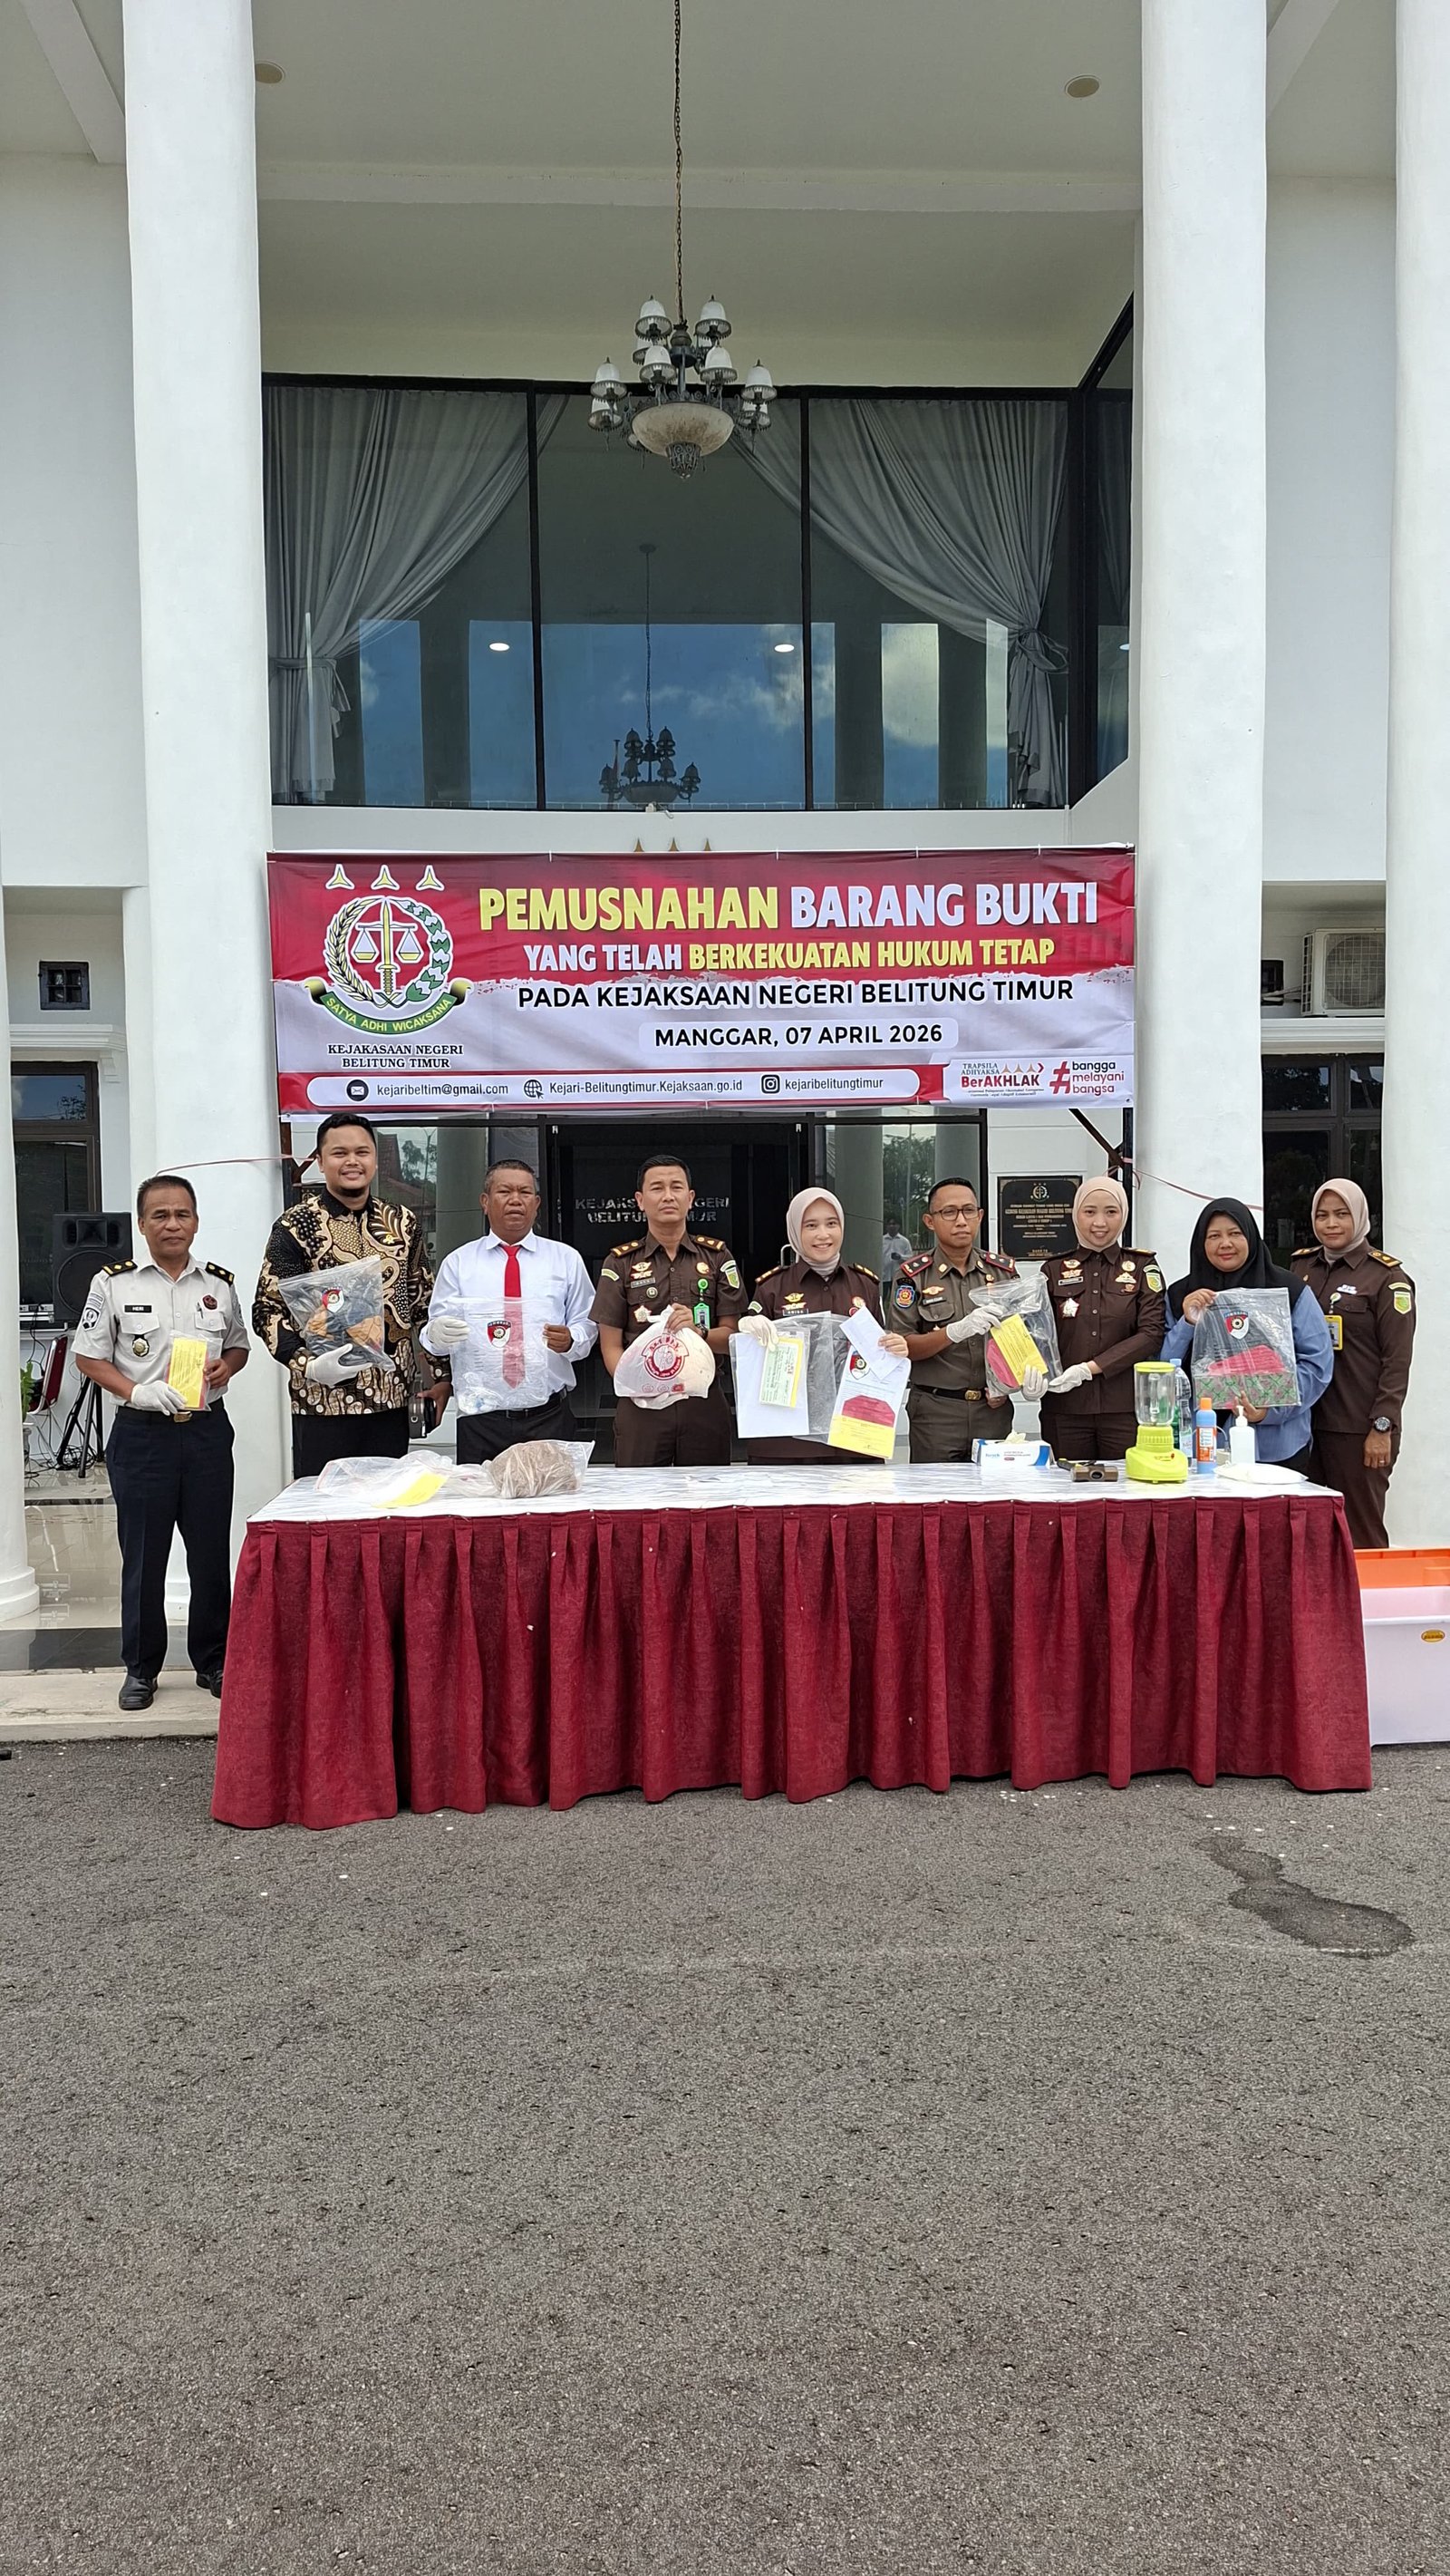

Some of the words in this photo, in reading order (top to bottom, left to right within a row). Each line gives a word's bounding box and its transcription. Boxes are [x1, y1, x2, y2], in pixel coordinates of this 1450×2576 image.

[478, 886, 778, 931] PEMUSNAHAN
[790, 883, 963, 928] BARANG
[975, 881, 1097, 925] BUKTI
[524, 944, 596, 972] YANG
[602, 944, 682, 971] TELAH
[690, 942, 870, 970] BERKEKUATAN
[877, 939, 973, 967] HUKUM
[980, 938, 1055, 964] TETAP
[519, 987, 589, 1007] PADA
[598, 985, 749, 1006] KEJAKSAAN
[760, 983, 852, 1005] NEGERI
[862, 981, 985, 1002] BELITUNG
[993, 979, 1073, 1001] TIMUR
[326, 998, 357, 1024] SATYA
[361, 1021, 387, 1031] ADHI
[392, 998, 452, 1031] WICAKSANA
[655, 1027, 778, 1048] MANGGAR,
[786, 1026, 812, 1045] 07
[818, 1025, 883, 1044] APRIL
[890, 1024, 942, 1042] 2026
[328, 1044, 411, 1055] KEJAKASAAN
[416, 1045, 463, 1055] NEGERI
[343, 1058, 405, 1068] BELITUNG
[410, 1058, 450, 1068] TIMUR
[1072, 1060, 1116, 1073] bangga
[785, 1077, 884, 1092] kejaribelitungtimur
[961, 1074, 1040, 1088] BerAKHLAK
[1072, 1071, 1125, 1084] melayani
[376, 1082, 509, 1098] kejaribeltim@gmail.com
[549, 1079, 743, 1096] Kejari-Belitungtimur.Kejaksaan.go.id
[1072, 1083, 1115, 1096] bangsa
[575, 1197, 637, 1210] KEJAKS
